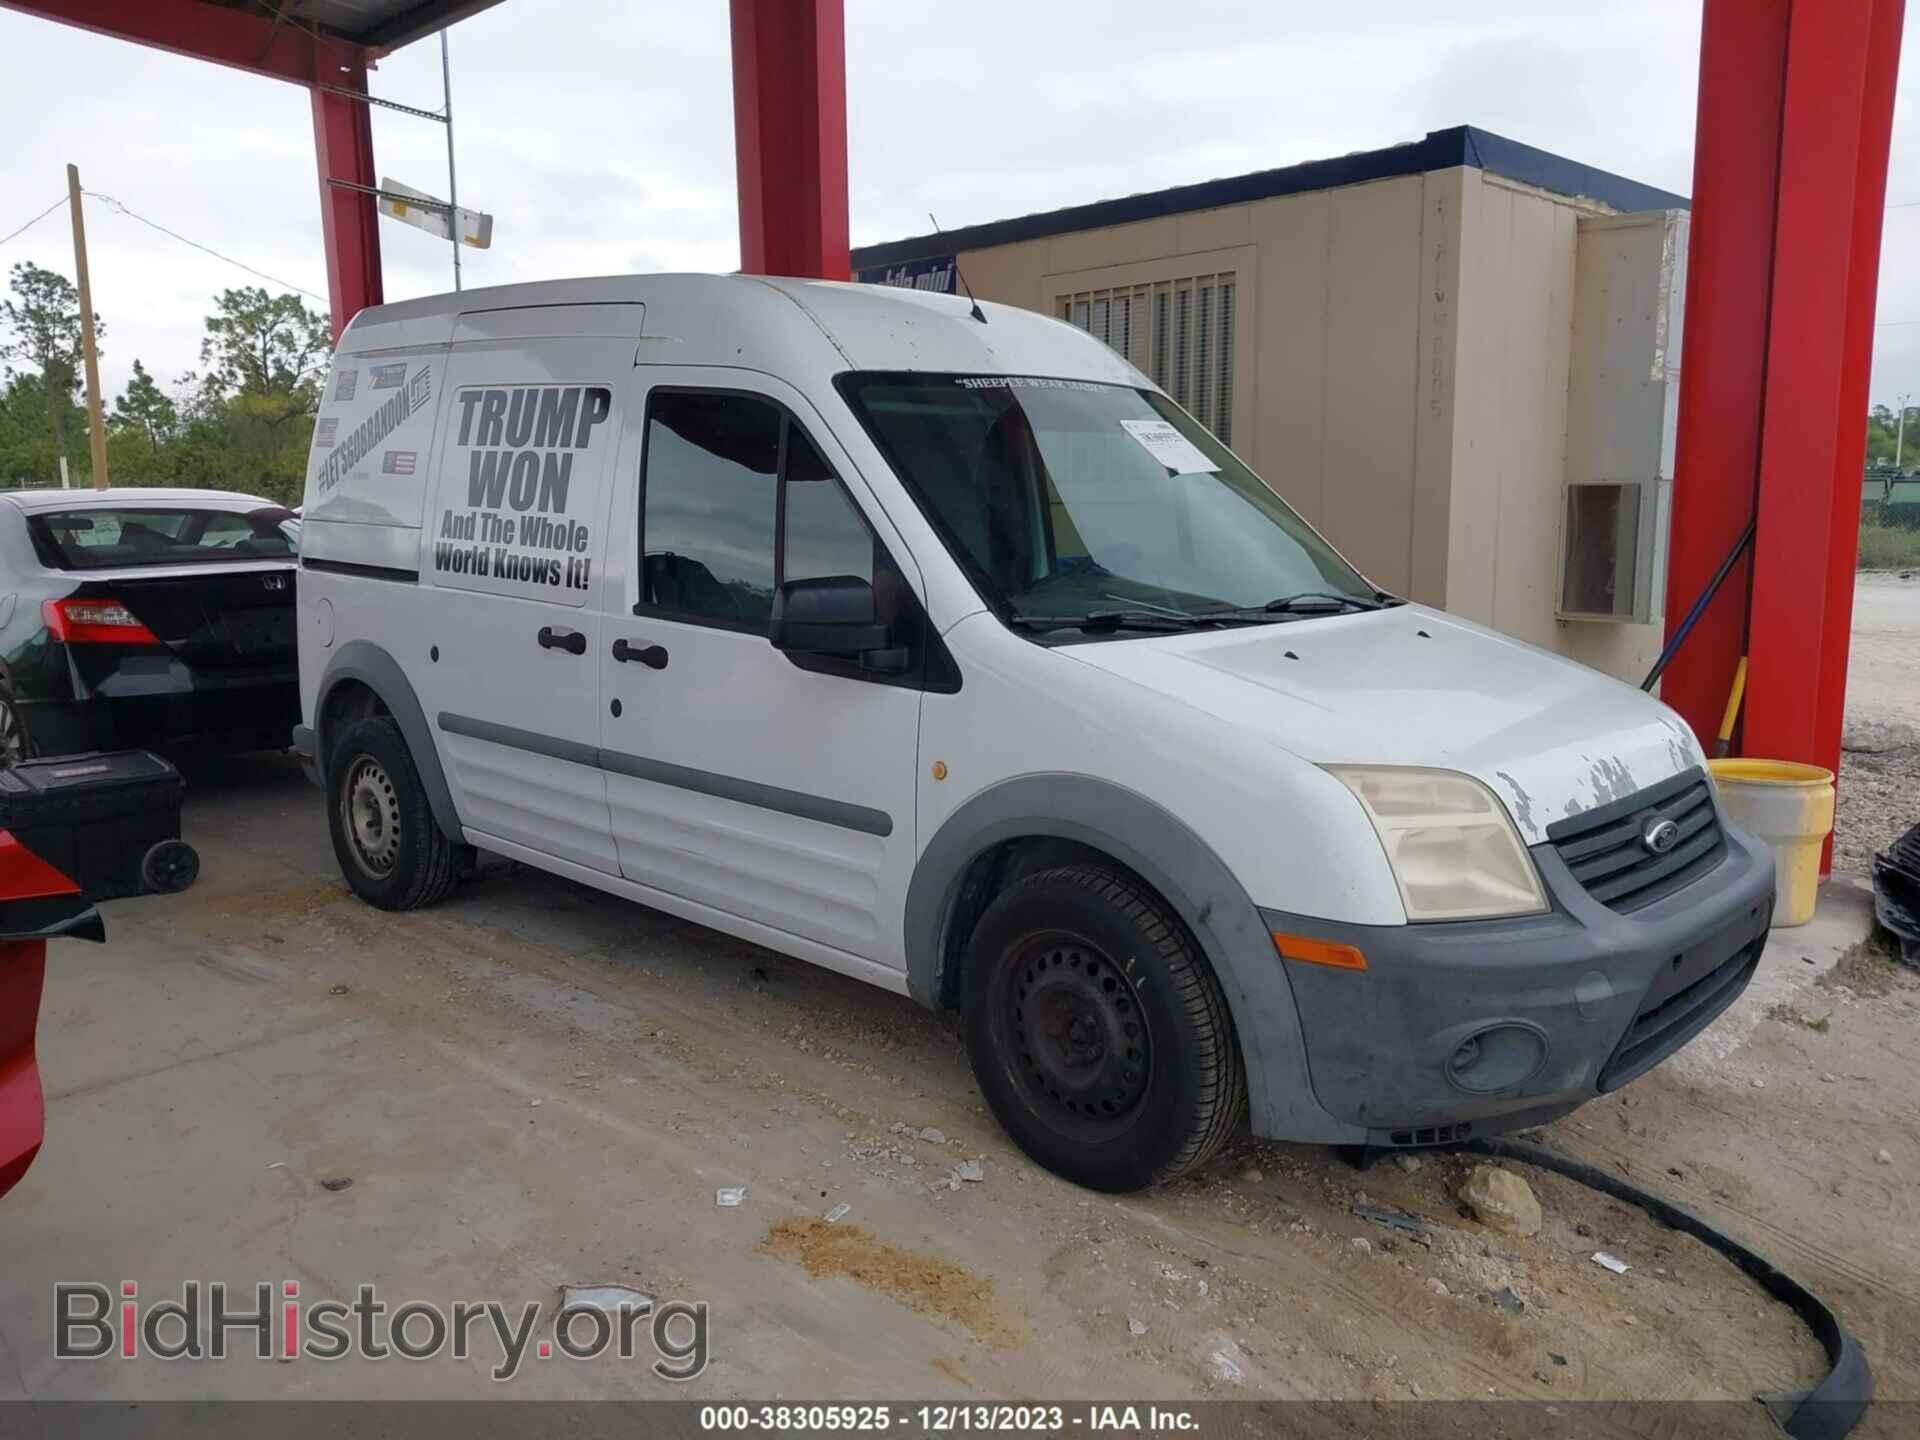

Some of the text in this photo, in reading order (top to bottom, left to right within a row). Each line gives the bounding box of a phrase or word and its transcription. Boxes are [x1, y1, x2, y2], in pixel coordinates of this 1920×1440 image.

[457, 388, 612, 448] TRUMP
[468, 450, 573, 514] WON
[440, 509, 588, 552] And The Whole
[435, 541, 592, 590] World Knows It!
